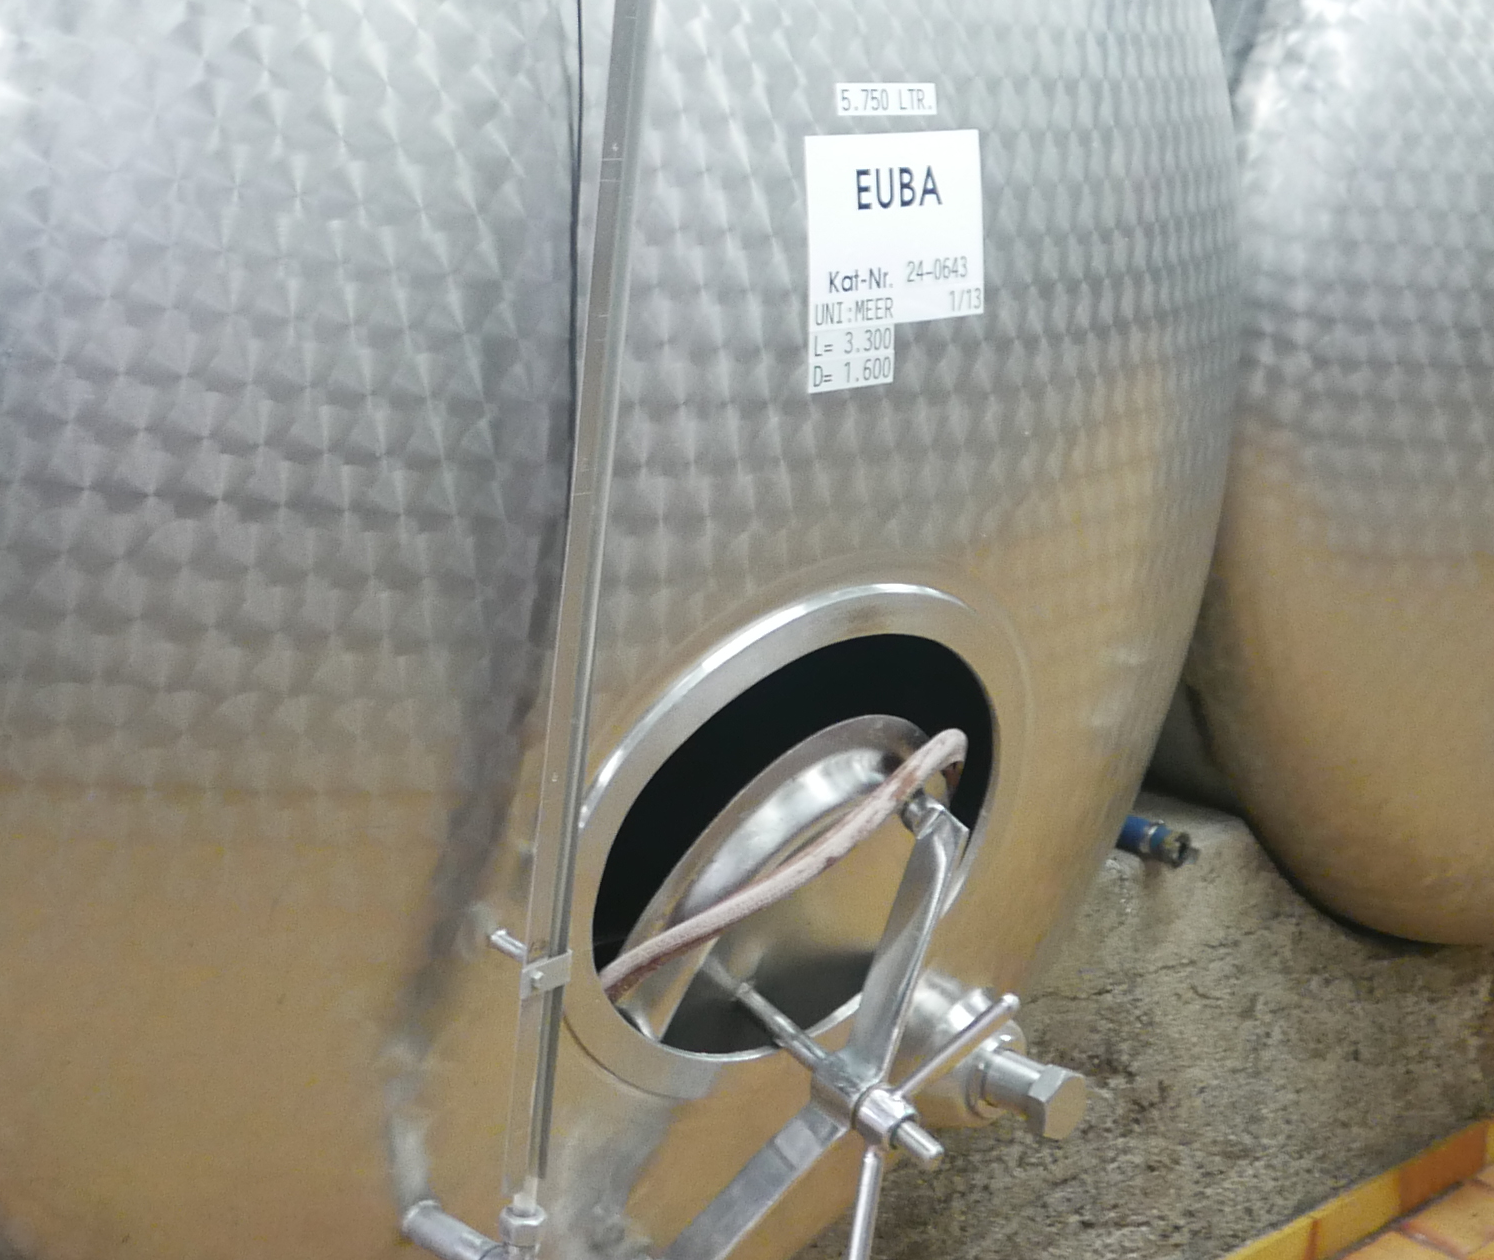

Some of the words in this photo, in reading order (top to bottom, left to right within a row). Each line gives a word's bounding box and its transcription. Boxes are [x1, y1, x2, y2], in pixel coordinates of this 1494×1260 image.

[841, 88, 889, 111] 5.750
[898, 88, 933, 110] LTR.
[855, 164, 943, 210] EUBA
[828, 267, 894, 294] Kat-Nr.
[906, 255, 968, 283] 24-0643
[814, 297, 894, 326] UNI:MEER
[949, 287, 982, 312] 1/13
[814, 335, 834, 357] L=
[843, 327, 892, 354] 3.300
[813, 365, 833, 388] D=
[843, 356, 892, 383] 1.600
